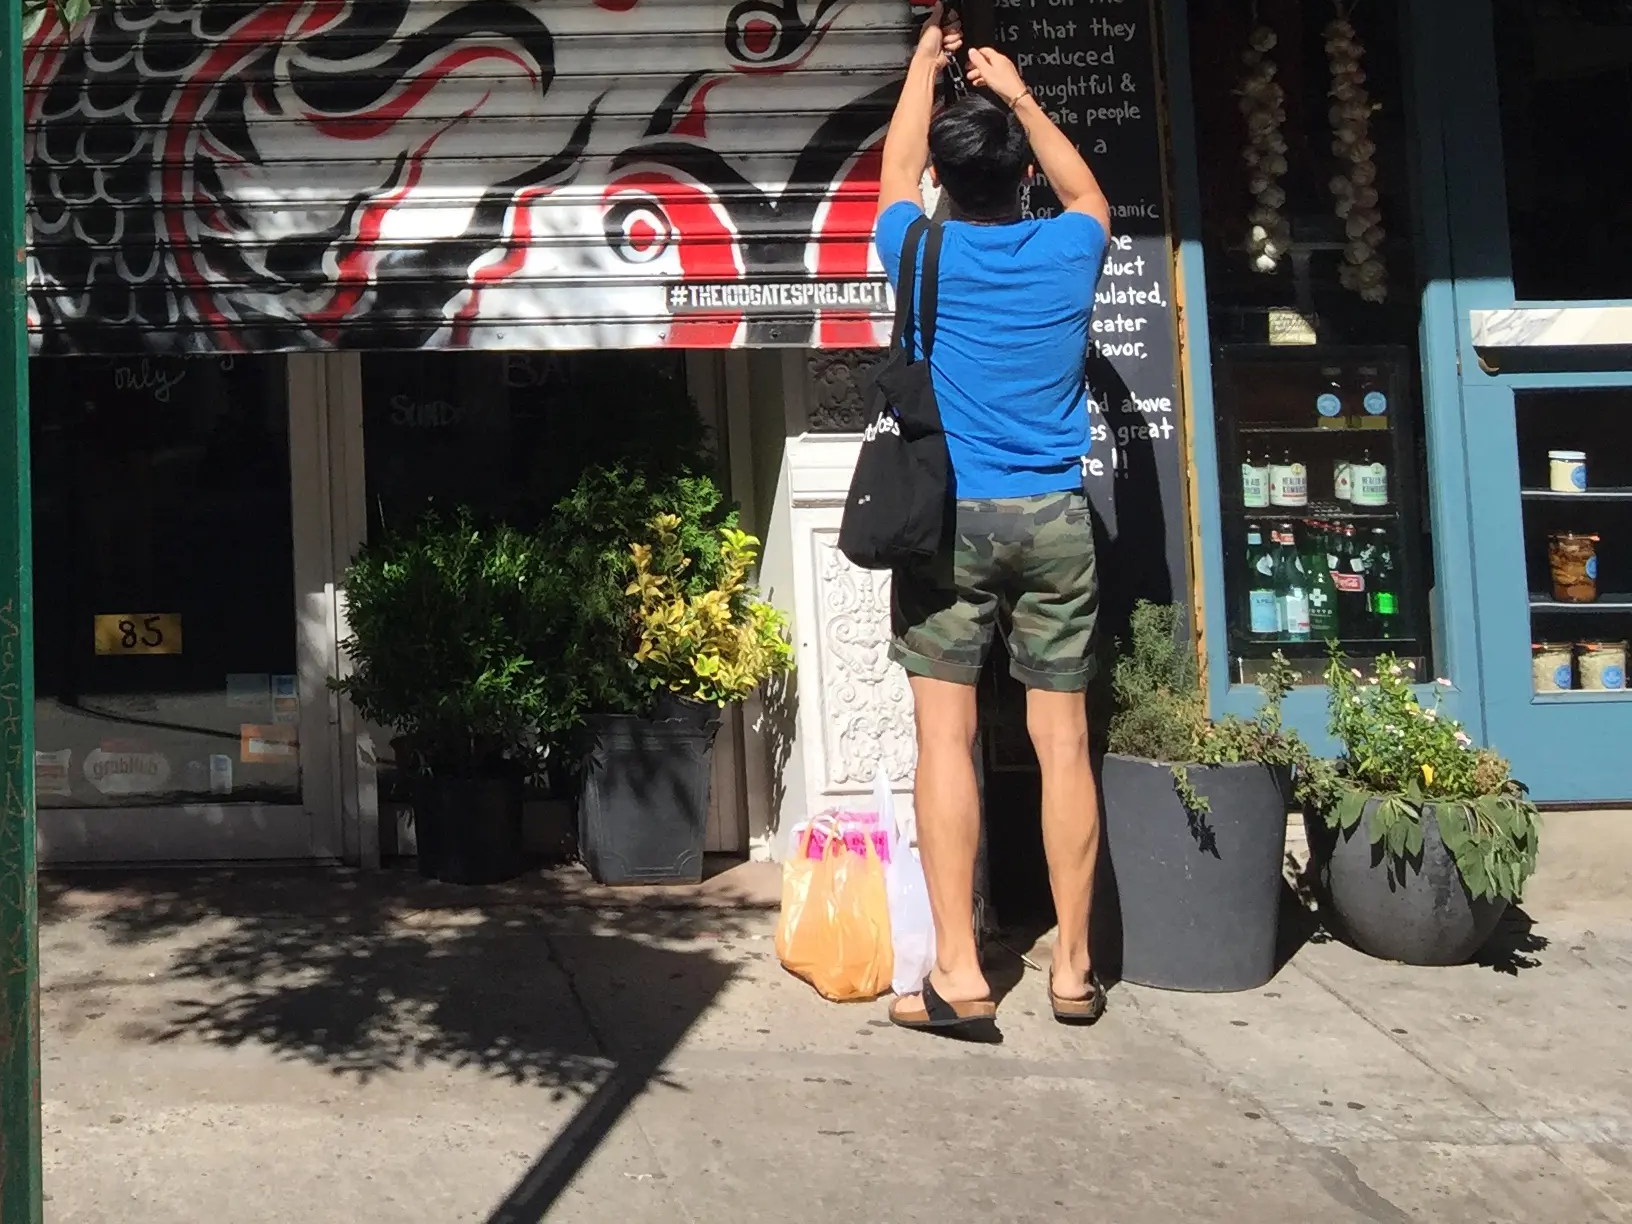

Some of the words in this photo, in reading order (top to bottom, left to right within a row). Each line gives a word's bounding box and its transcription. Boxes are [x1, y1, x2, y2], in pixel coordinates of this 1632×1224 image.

[1031, 18, 1077, 40] that
[1089, 17, 1136, 42] they
[1018, 45, 1116, 68] produced
[1086, 100, 1141, 128] people
[1093, 137, 1108, 155] a
[1103, 255, 1146, 277] duct
[1120, 390, 1172, 414] above
[1117, 416, 1175, 447] great
[118, 615, 164, 649] 85
